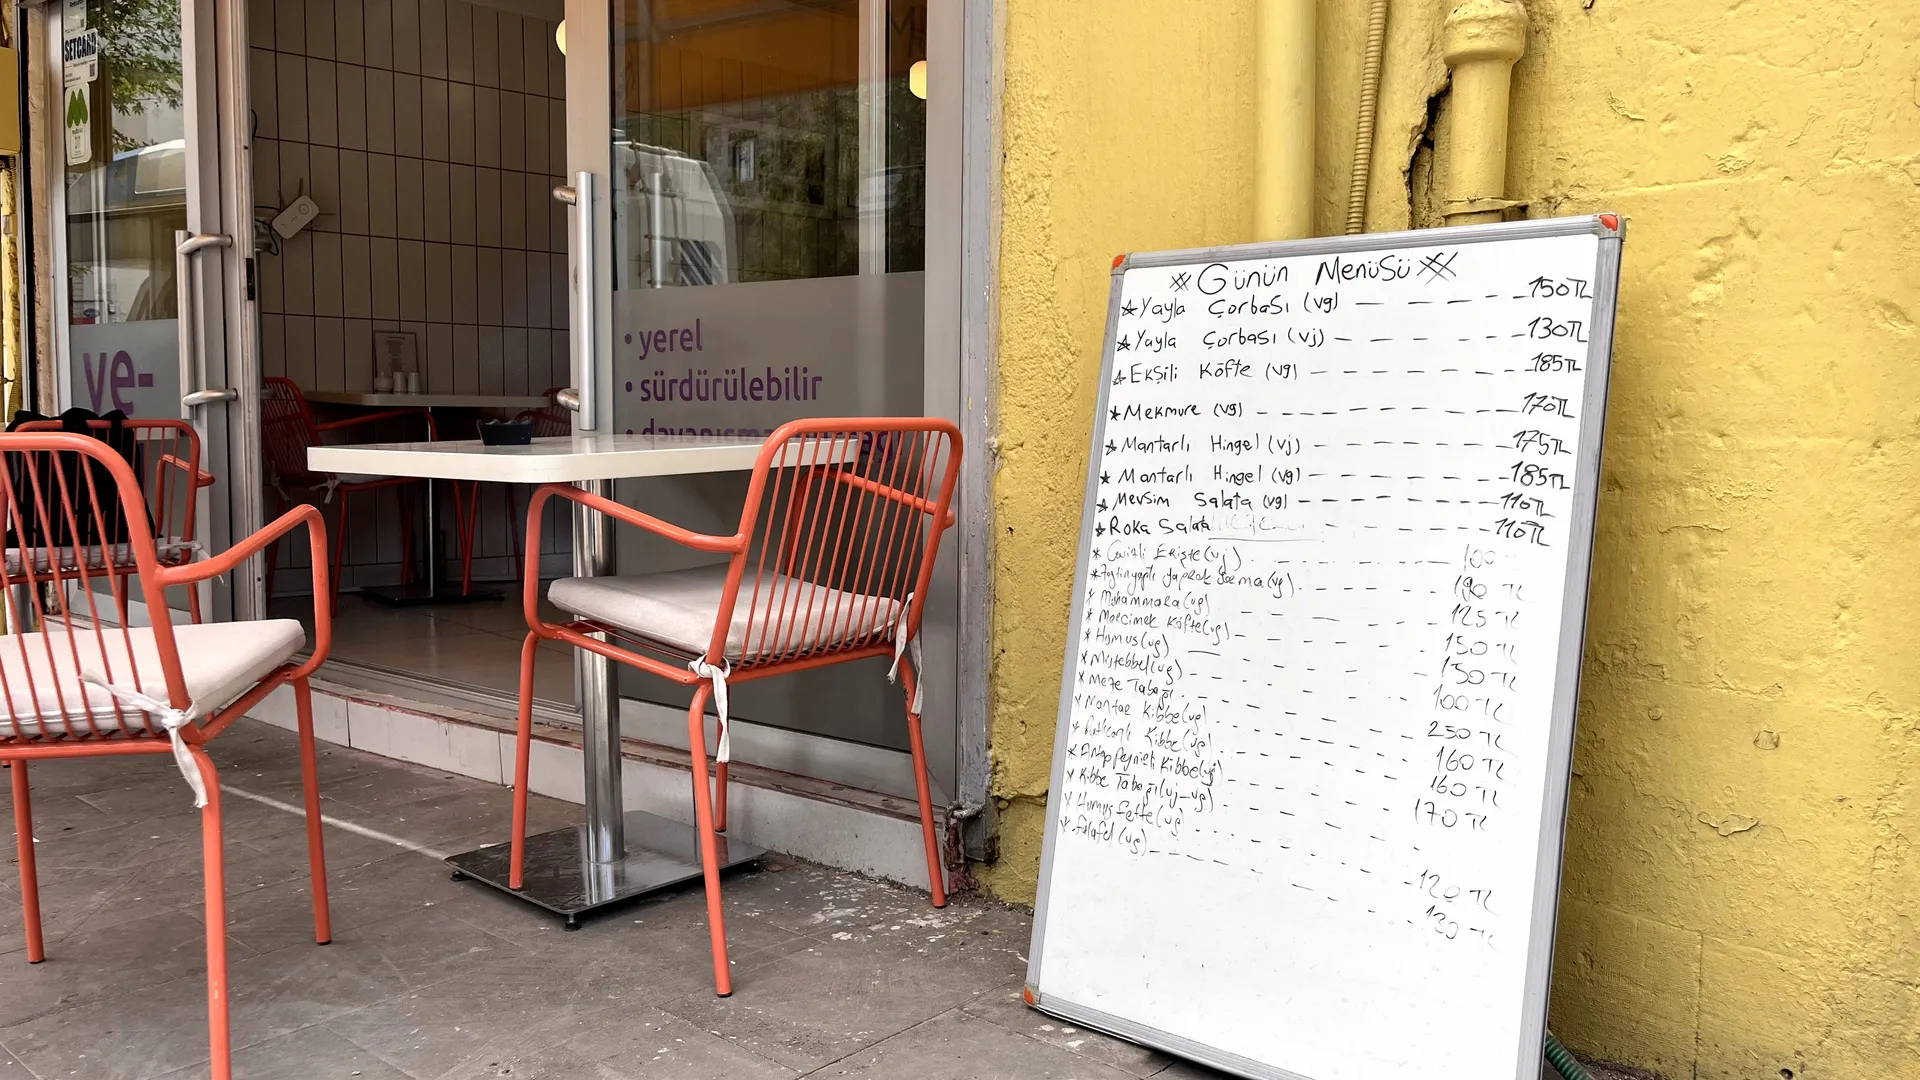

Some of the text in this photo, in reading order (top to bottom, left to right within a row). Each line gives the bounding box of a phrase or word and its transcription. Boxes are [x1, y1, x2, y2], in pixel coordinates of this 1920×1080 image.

[65, 32, 96, 62] SETCARD
[1197, 262, 1288, 295] Günün
[1139, 297, 1186, 323] Yayla
[639, 318, 702, 360] yerel
[1135, 330, 1177, 353] Yayla
[640, 366, 823, 401] sürdürülebilir
[1121, 434, 1190, 454] Mantarlı
[1210, 433, 1260, 456] Hingel
[1118, 465, 1193, 485] Mantarlı
[1213, 464, 1262, 486] Hingel
[1194, 490, 1253, 510] Salata
[1158, 514, 1211, 535] Salata
[1451, 603, 1487, 628] 125
[1445, 632, 1488, 655] 150
[1433, 684, 1470, 712] 100
[1428, 720, 1471, 739] 250
[1436, 746, 1474, 772] 160
[1430, 774, 1466, 797] 160
[1415, 799, 1457, 828] 170
